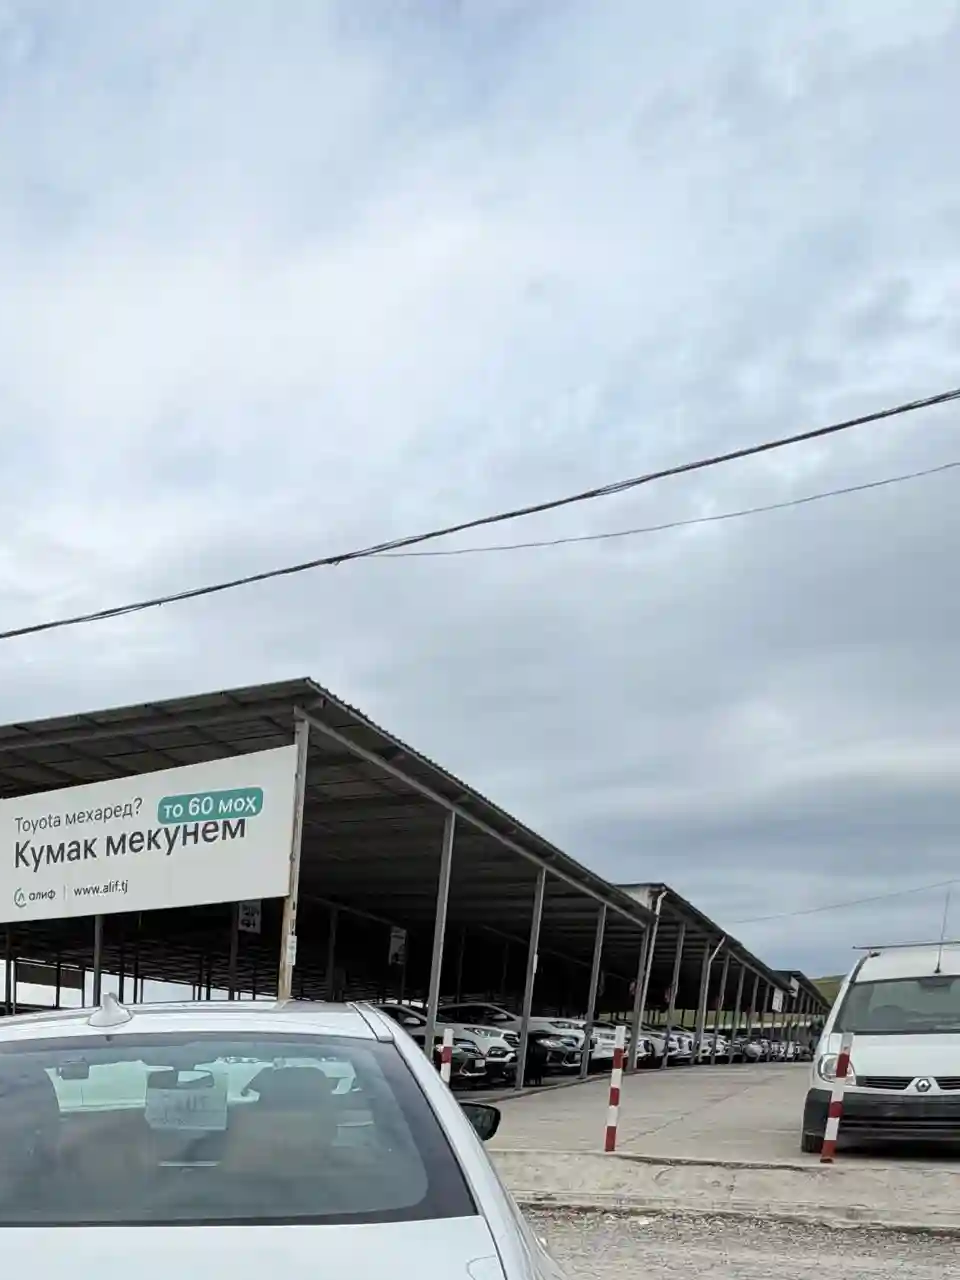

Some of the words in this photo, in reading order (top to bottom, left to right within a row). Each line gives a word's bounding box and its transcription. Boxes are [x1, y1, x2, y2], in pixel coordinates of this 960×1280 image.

[14, 814, 61, 835] Toyota
[65, 797, 143, 825] мехаред?
[163, 804, 184, 819] то
[188, 797, 214, 816] 60
[14, 839, 98, 873] Кумак
[105, 818, 246, 857] мекунем
[73, 879, 129, 897] www.alif.tj
